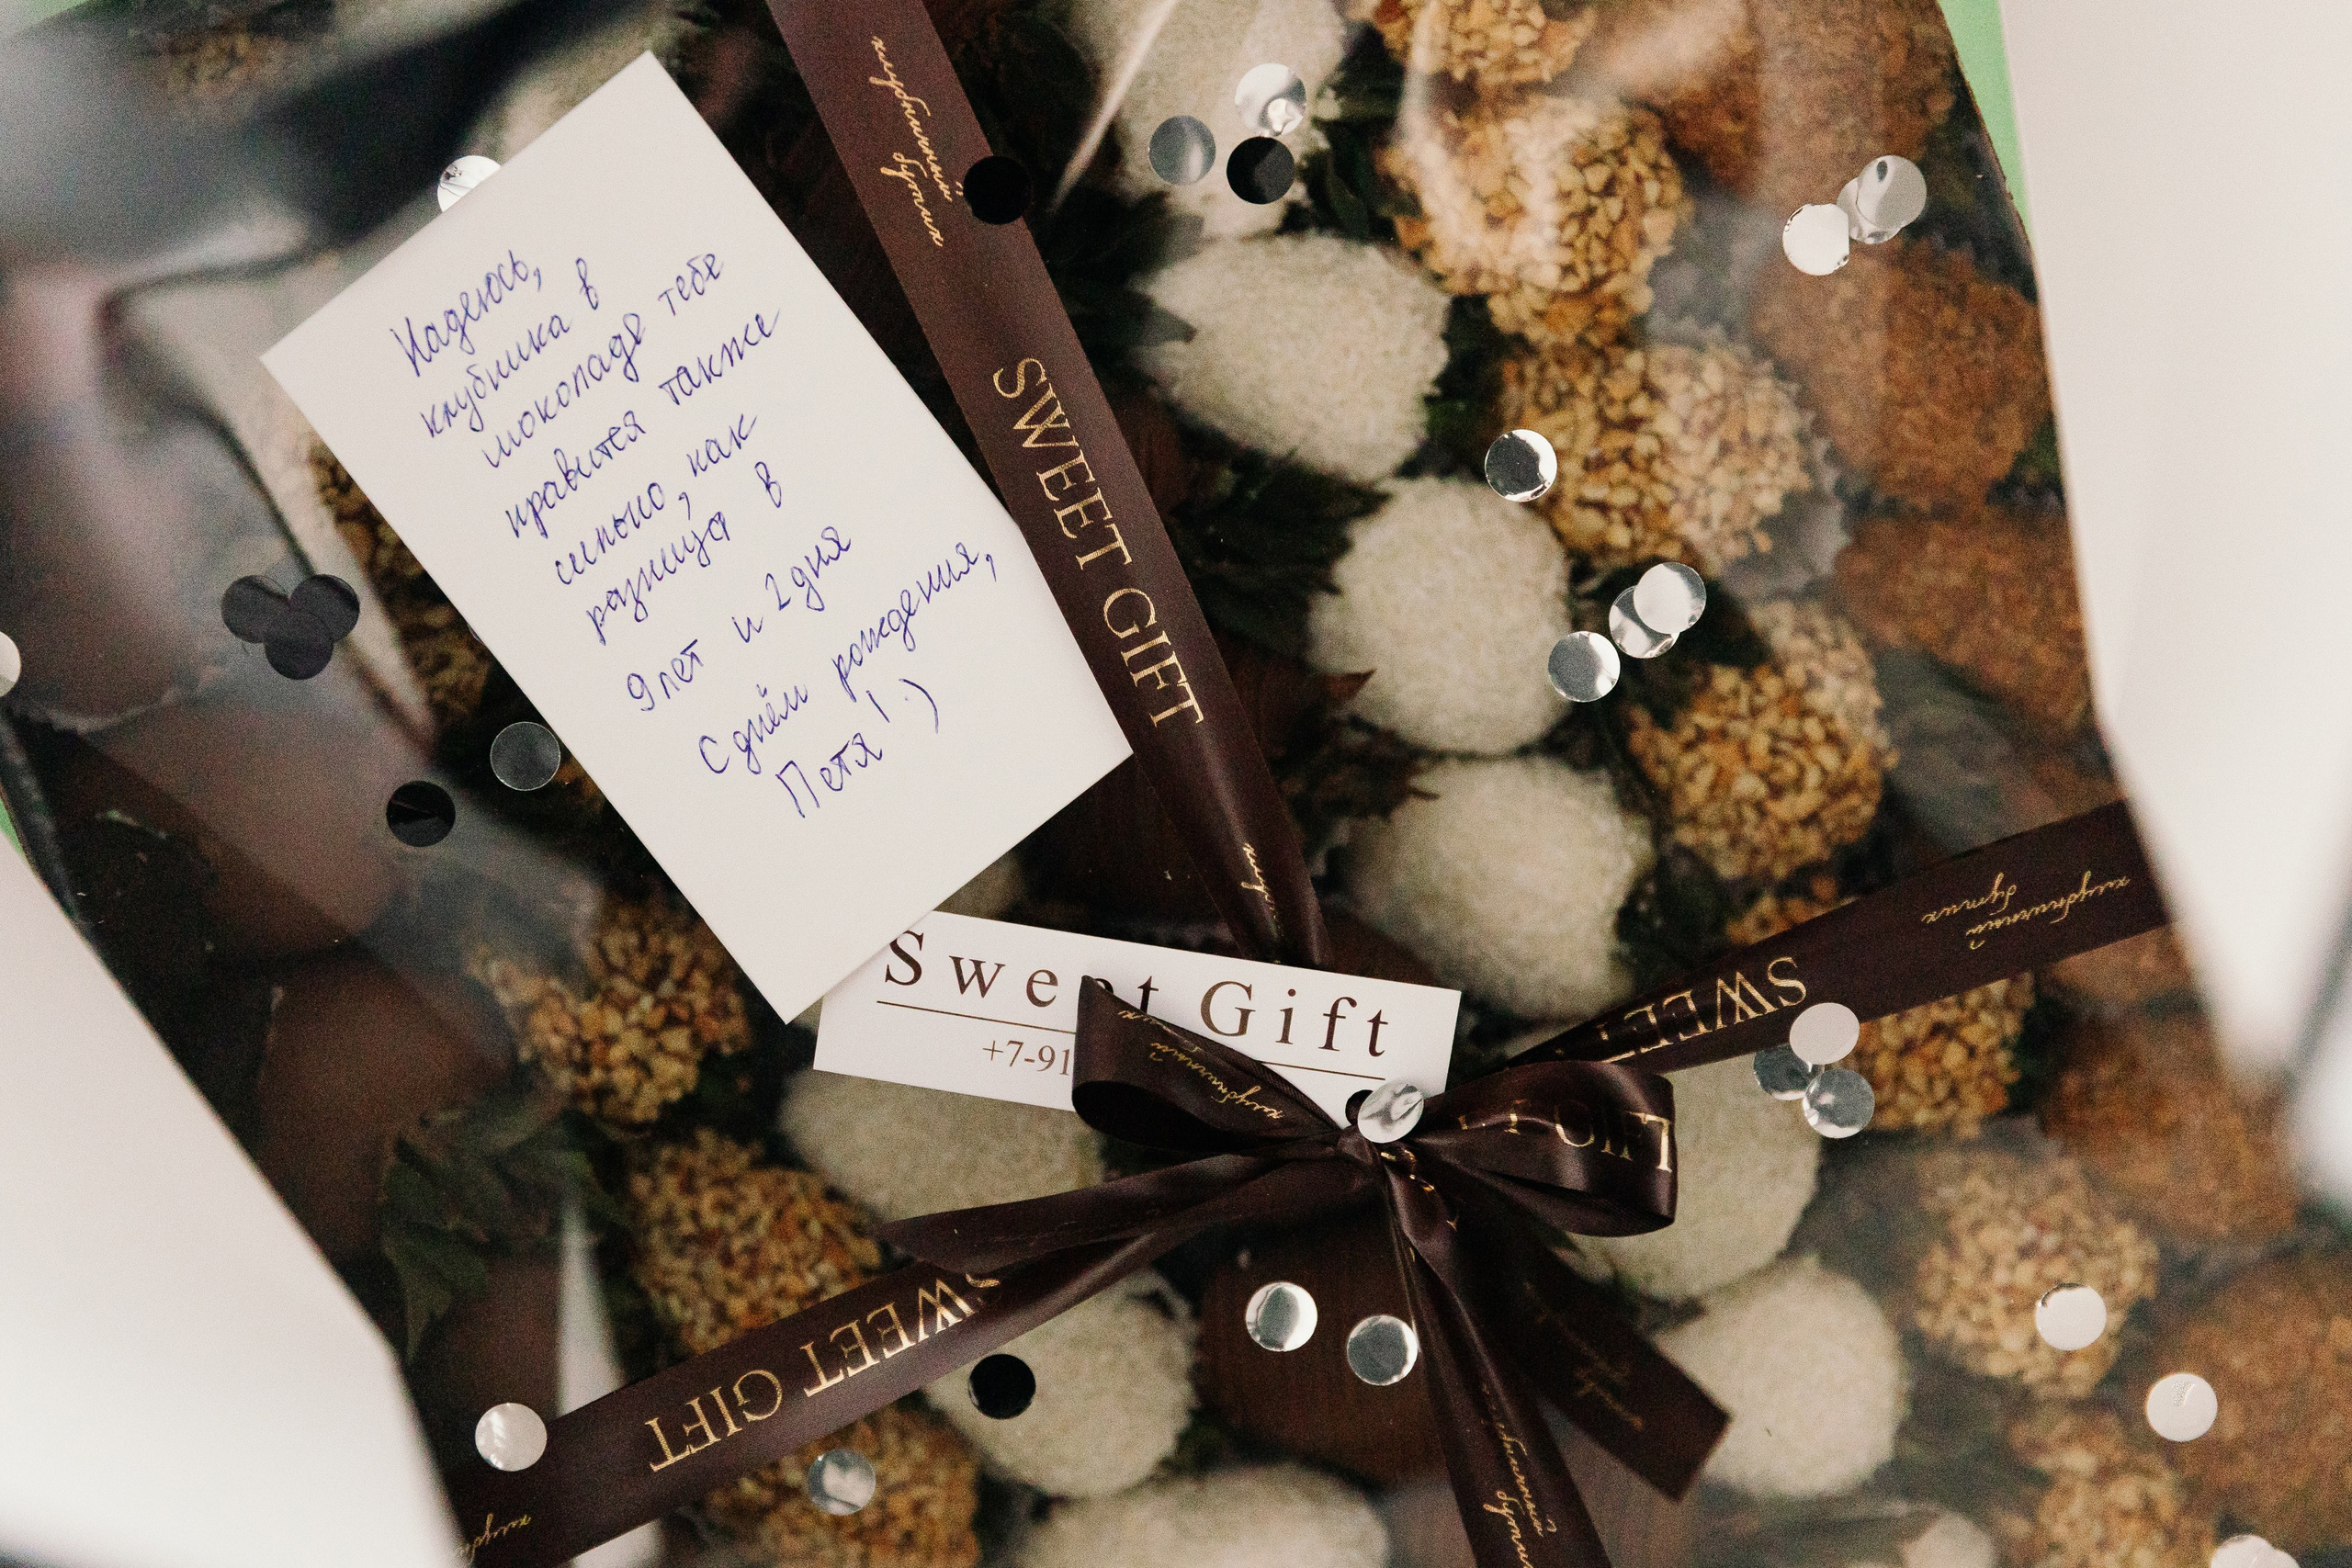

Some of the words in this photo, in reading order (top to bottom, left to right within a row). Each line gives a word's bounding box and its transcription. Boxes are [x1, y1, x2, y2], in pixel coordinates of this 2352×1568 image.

[391, 250, 543, 378] Надеюсь,
[419, 314, 575, 438] клубника
[575, 257, 600, 310] в
[481, 313, 647, 468] шоколаде
[658, 253, 724, 317] тебе
[505, 411, 647, 539] нравится
[659, 309, 781, 406] также
[555, 481, 692, 586] сильно,
[686, 413, 757, 478] как
[585, 511, 731, 646] разница
[755, 461, 783, 509] в
[831, 541, 998, 704] рождения,
[992, 357, 1133, 570] SWEET
[1102, 587, 1204, 728] GIFT
[731, 615, 764, 644] и
[884, 929, 1159, 1016] Swet
[1200, 979, 1389, 1059] Gift
[644, 1370, 784, 1472] GIFT
[1482, 1489, 1534, 1568] бути
